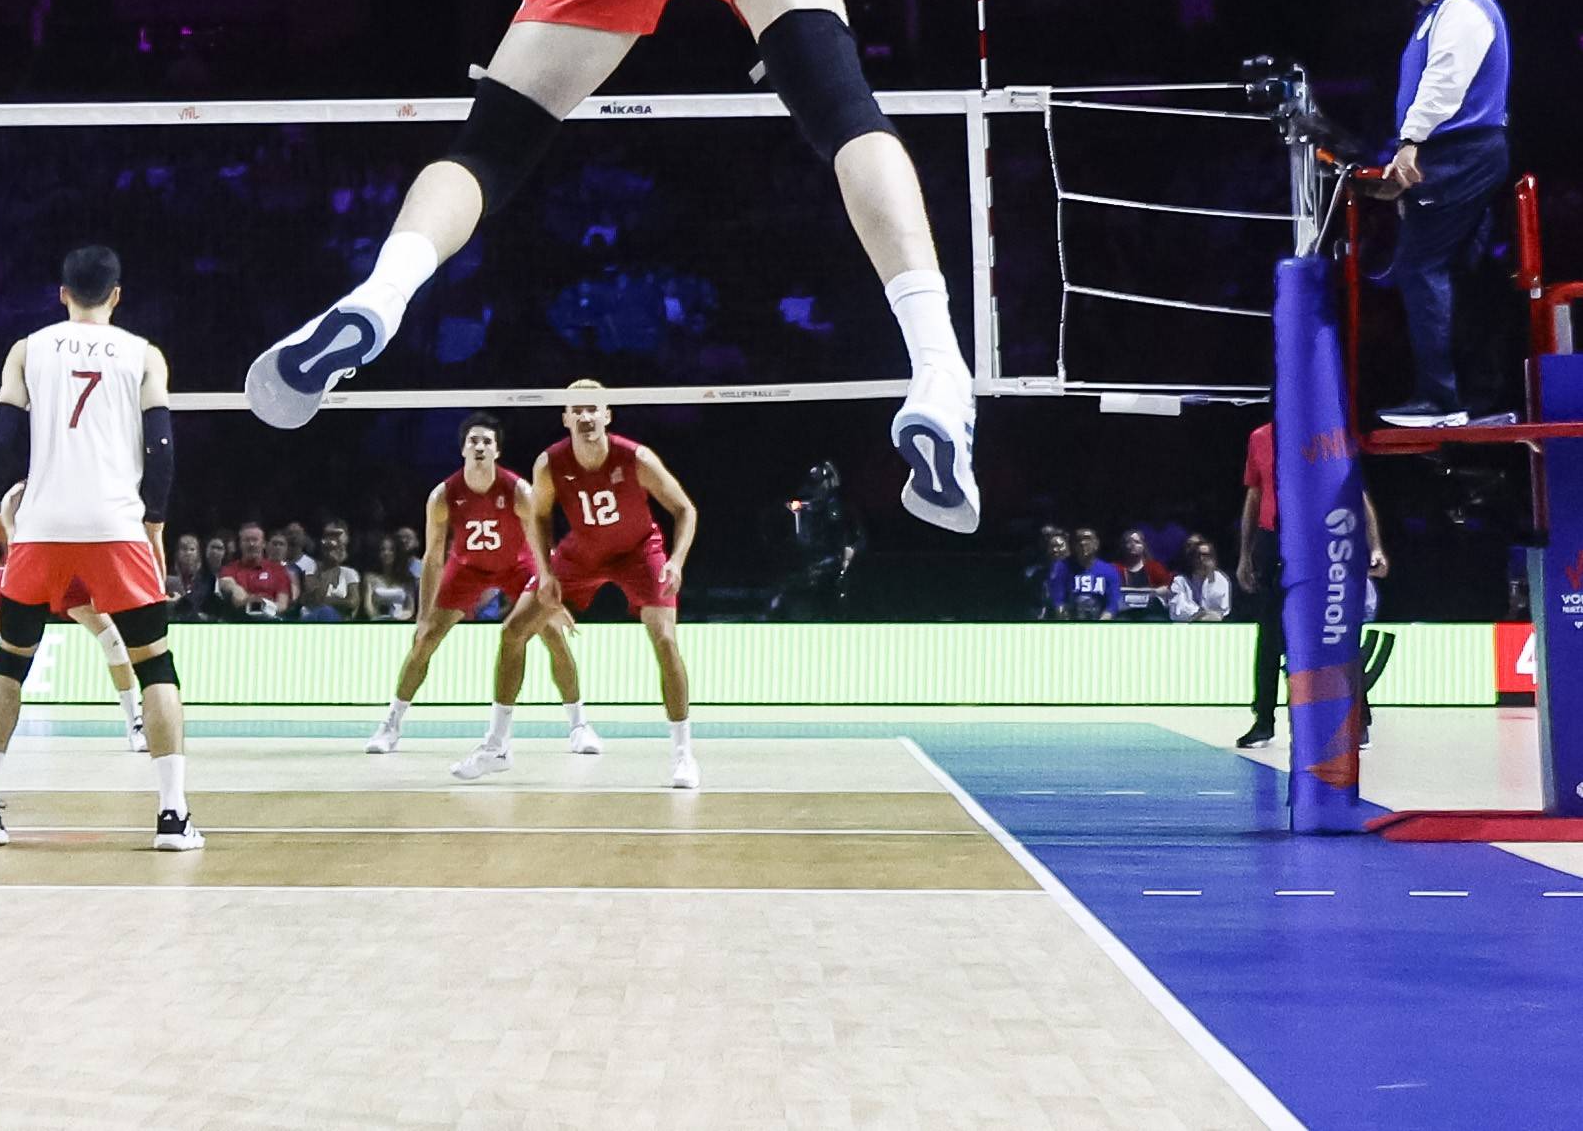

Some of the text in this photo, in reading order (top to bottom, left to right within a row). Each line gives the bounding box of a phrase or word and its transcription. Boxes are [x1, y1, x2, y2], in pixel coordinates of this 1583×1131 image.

[55, 337, 80, 354] YU
[69, 370, 102, 429] 7
[578, 490, 620, 526] 12
[465, 520, 501, 551] 25
[1322, 538, 1353, 645] Senoh
[1515, 631, 1538, 685] 4
